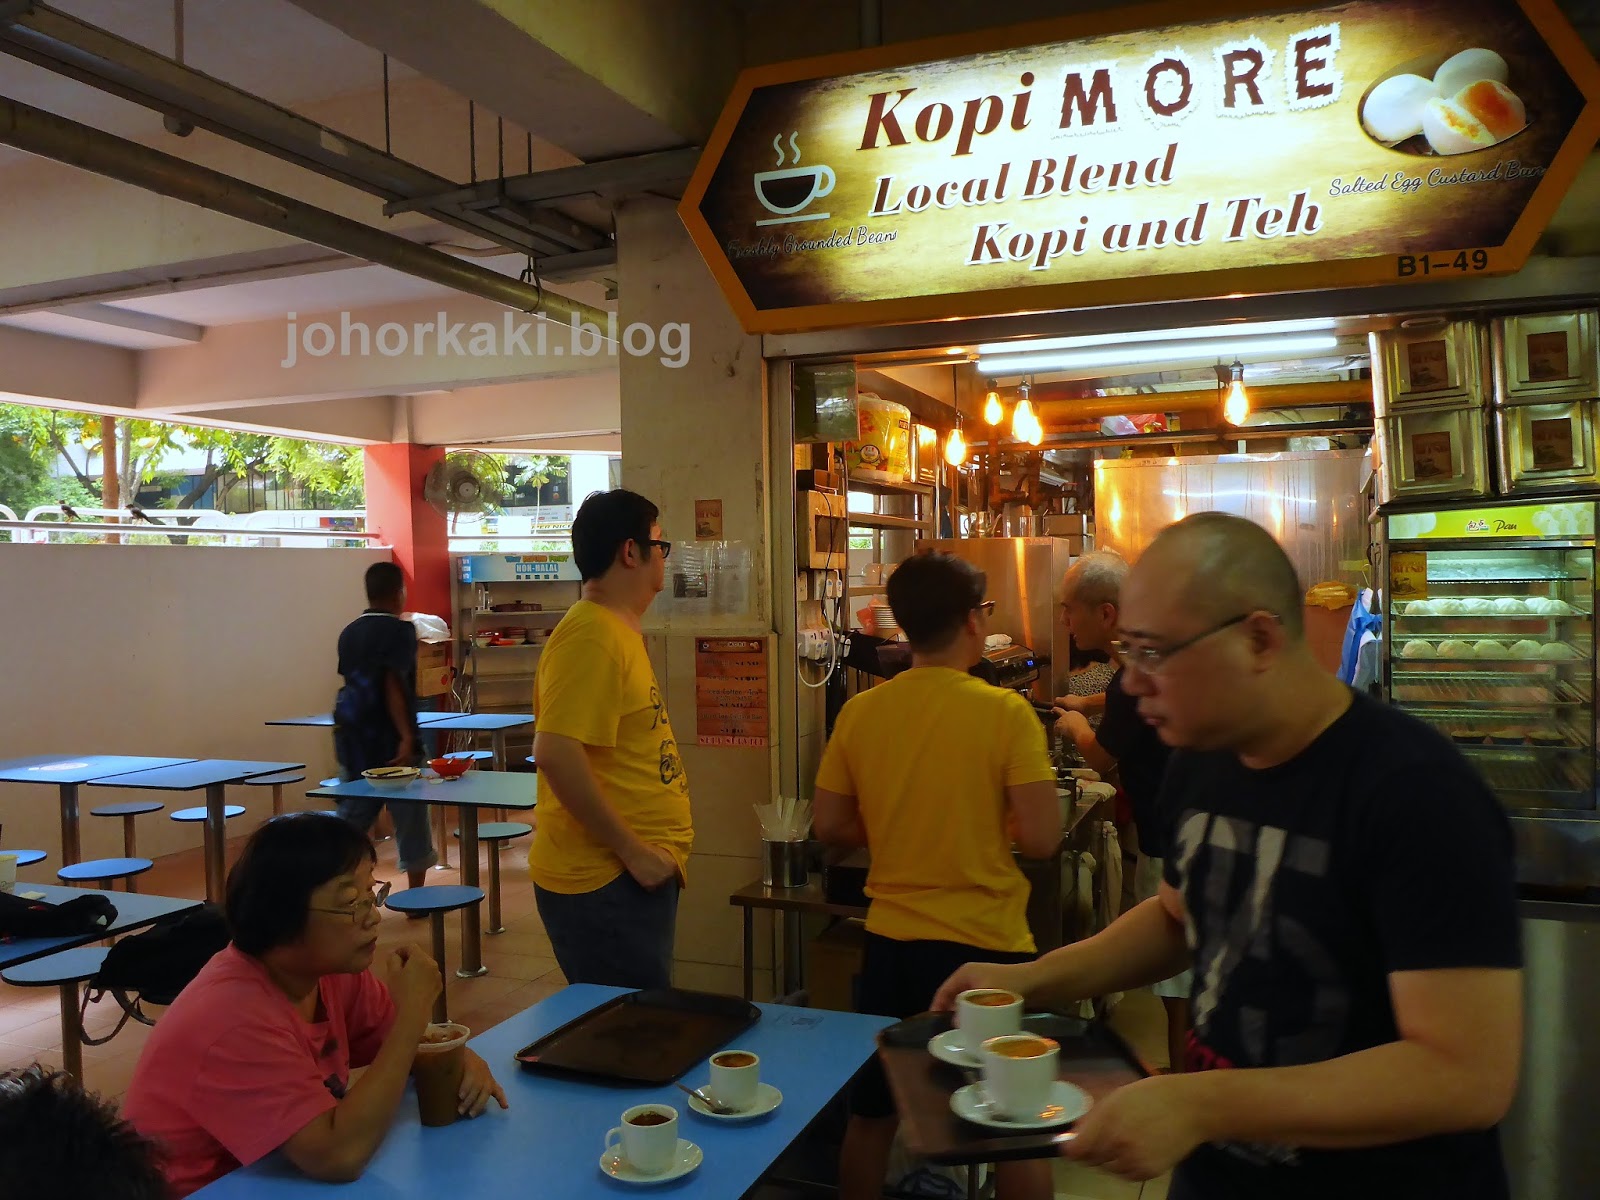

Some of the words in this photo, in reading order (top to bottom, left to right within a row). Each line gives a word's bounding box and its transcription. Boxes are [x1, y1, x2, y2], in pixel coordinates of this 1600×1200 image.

[856, 71, 1036, 156] Kopi
[1058, 32, 1334, 130] MORE
[868, 162, 1012, 217] Local
[1021, 142, 1180, 201] Blend
[1328, 173, 1389, 197] Salted
[1389, 171, 1423, 195] Egg
[1427, 162, 1501, 188] Custard
[727, 236, 781, 261] Freshly
[783, 226, 855, 255] Grounded
[856, 225, 899, 247] Beans
[965, 215, 1089, 272] Kopi
[1100, 202, 1210, 252] and
[1222, 190, 1324, 243] Teh
[1397, 250, 1489, 277] B1-49
[1493, 519, 1517, 533] Pau
[516, 563, 558, 573] NON-HALAL
